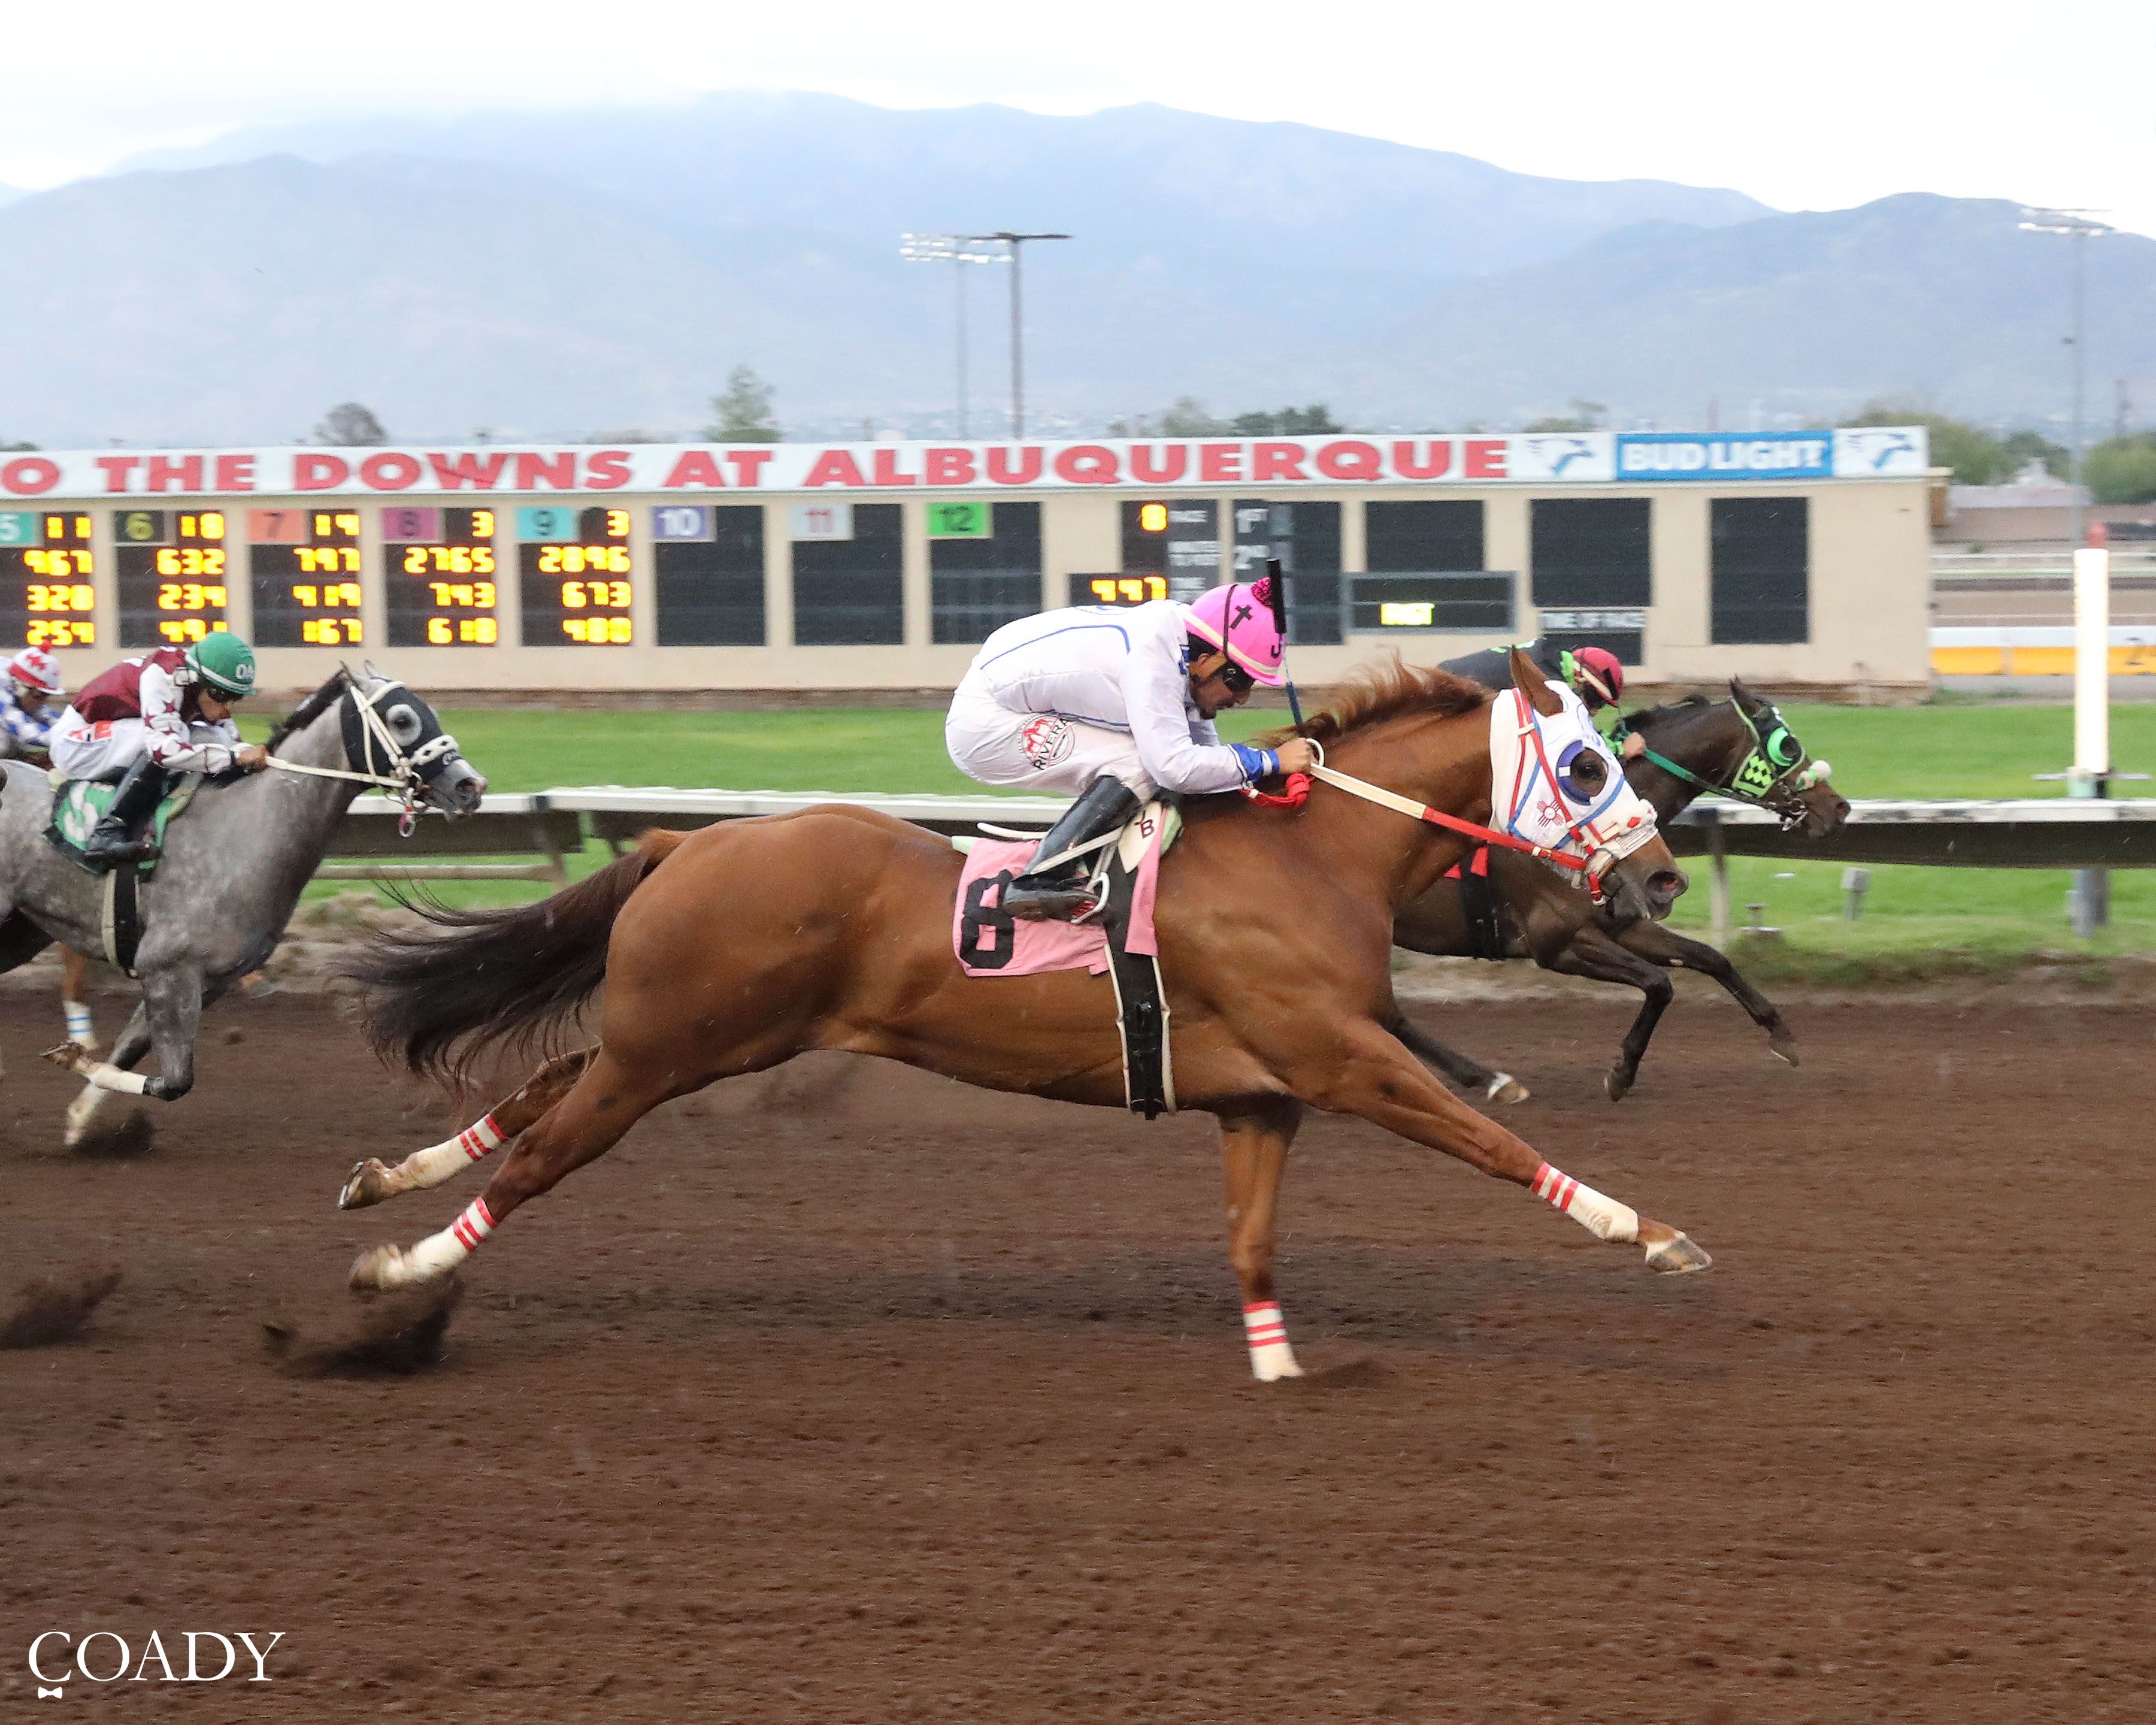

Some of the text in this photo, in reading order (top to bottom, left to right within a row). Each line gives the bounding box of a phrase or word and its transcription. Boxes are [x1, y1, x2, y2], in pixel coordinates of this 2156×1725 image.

[96, 455, 255, 492] THE
[293, 452, 632, 491] DOWNS
[662, 450, 772, 488] AT
[803, 440, 1507, 487] ALBUQUERQUE
[1622, 440, 1827, 471] BUD LIGHT
[126, 512, 154, 540] 6
[264, 512, 286, 539] 7
[398, 509, 422, 537] 8
[471, 510, 496, 538] 3
[531, 509, 557, 537] 9
[605, 509, 632, 537] 3
[658, 509, 700, 536] 10
[805, 509, 834, 533] 11
[939, 506, 973, 532] 12
[156, 547, 229, 576] 632
[561, 581, 634, 609] 673
[1032, 718, 1070, 770] RIVERA
